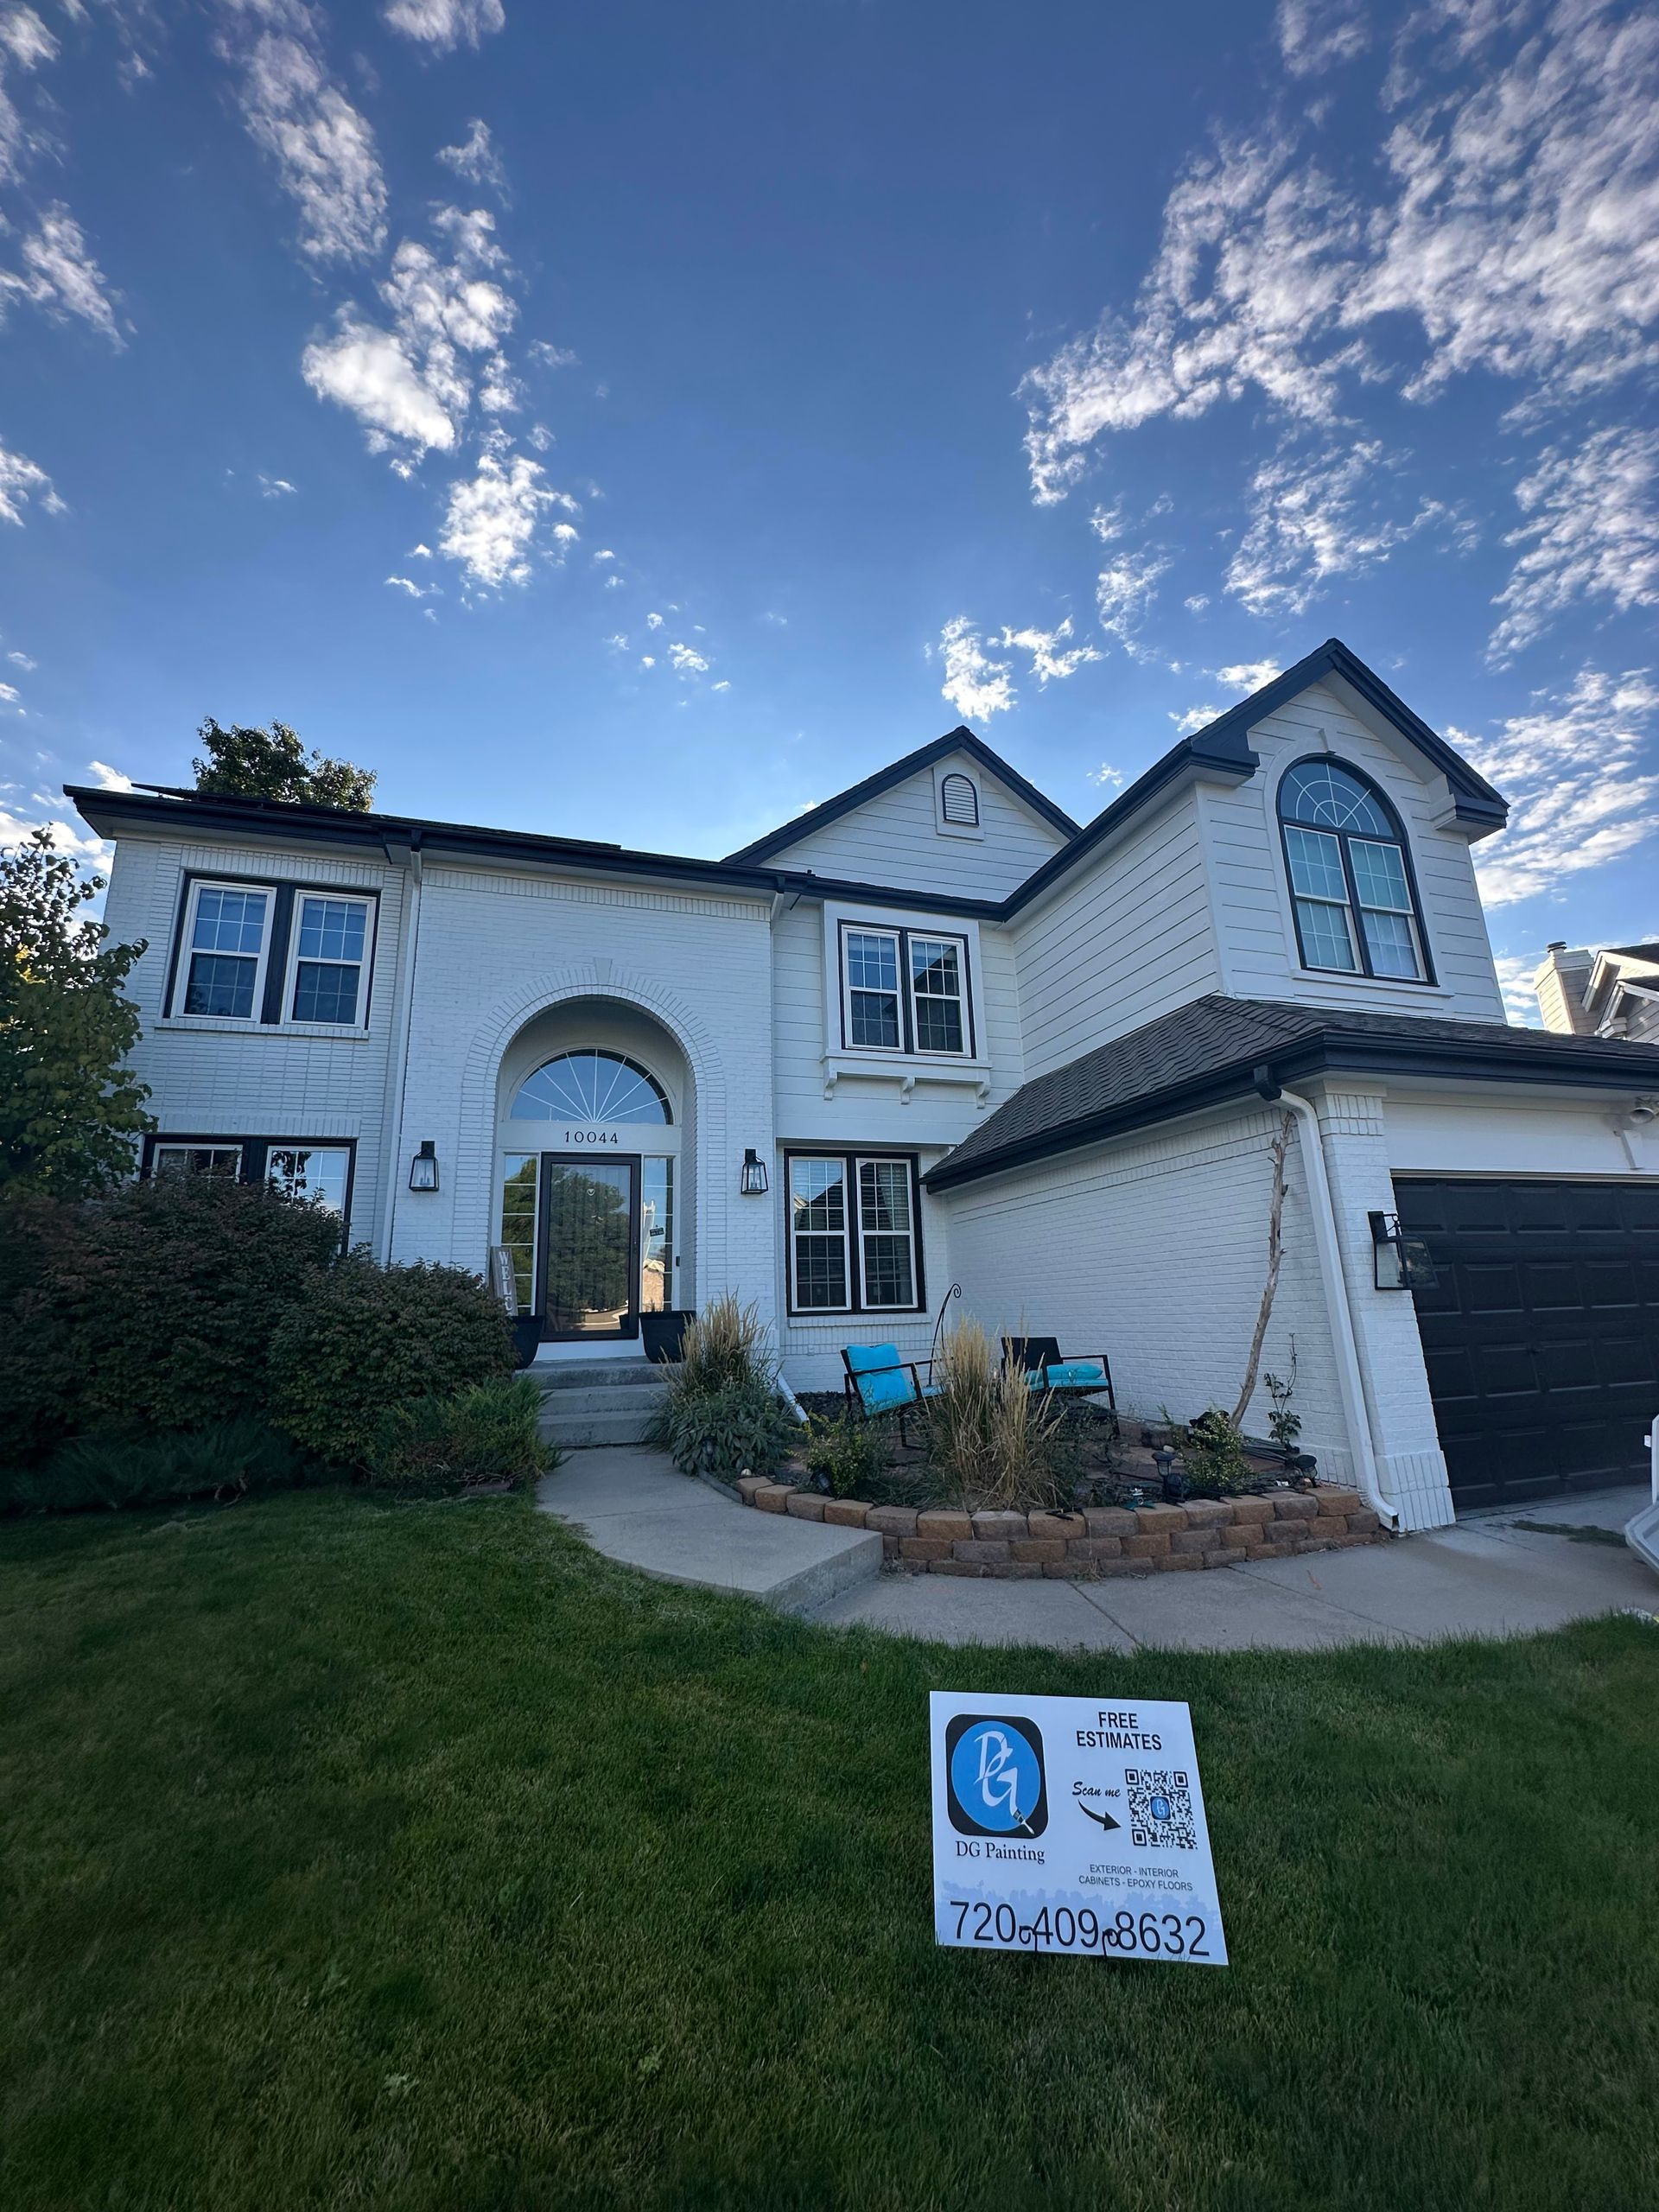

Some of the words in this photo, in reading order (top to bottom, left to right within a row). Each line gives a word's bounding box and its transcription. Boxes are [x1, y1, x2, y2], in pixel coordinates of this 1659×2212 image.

[564, 1130, 619, 1144] 10044
[1098, 1711, 1139, 1729] FREE
[1076, 1730, 1162, 1751] ESTIMATES
[1071, 1781, 1102, 1796] Scan
[1104, 1788, 1121, 1797] me
[955, 1840, 981, 1857] DG
[985, 1841, 1046, 1865] Painting
[1090, 1864, 1132, 1875] EXTERIOR
[1139, 1866, 1179, 1878] INTERIOR
[1078, 1875, 1121, 1886] CABINETS
[1127, 1878, 1156, 1889] EPOXY
[1158, 1880, 1193, 1891] FLOORS
